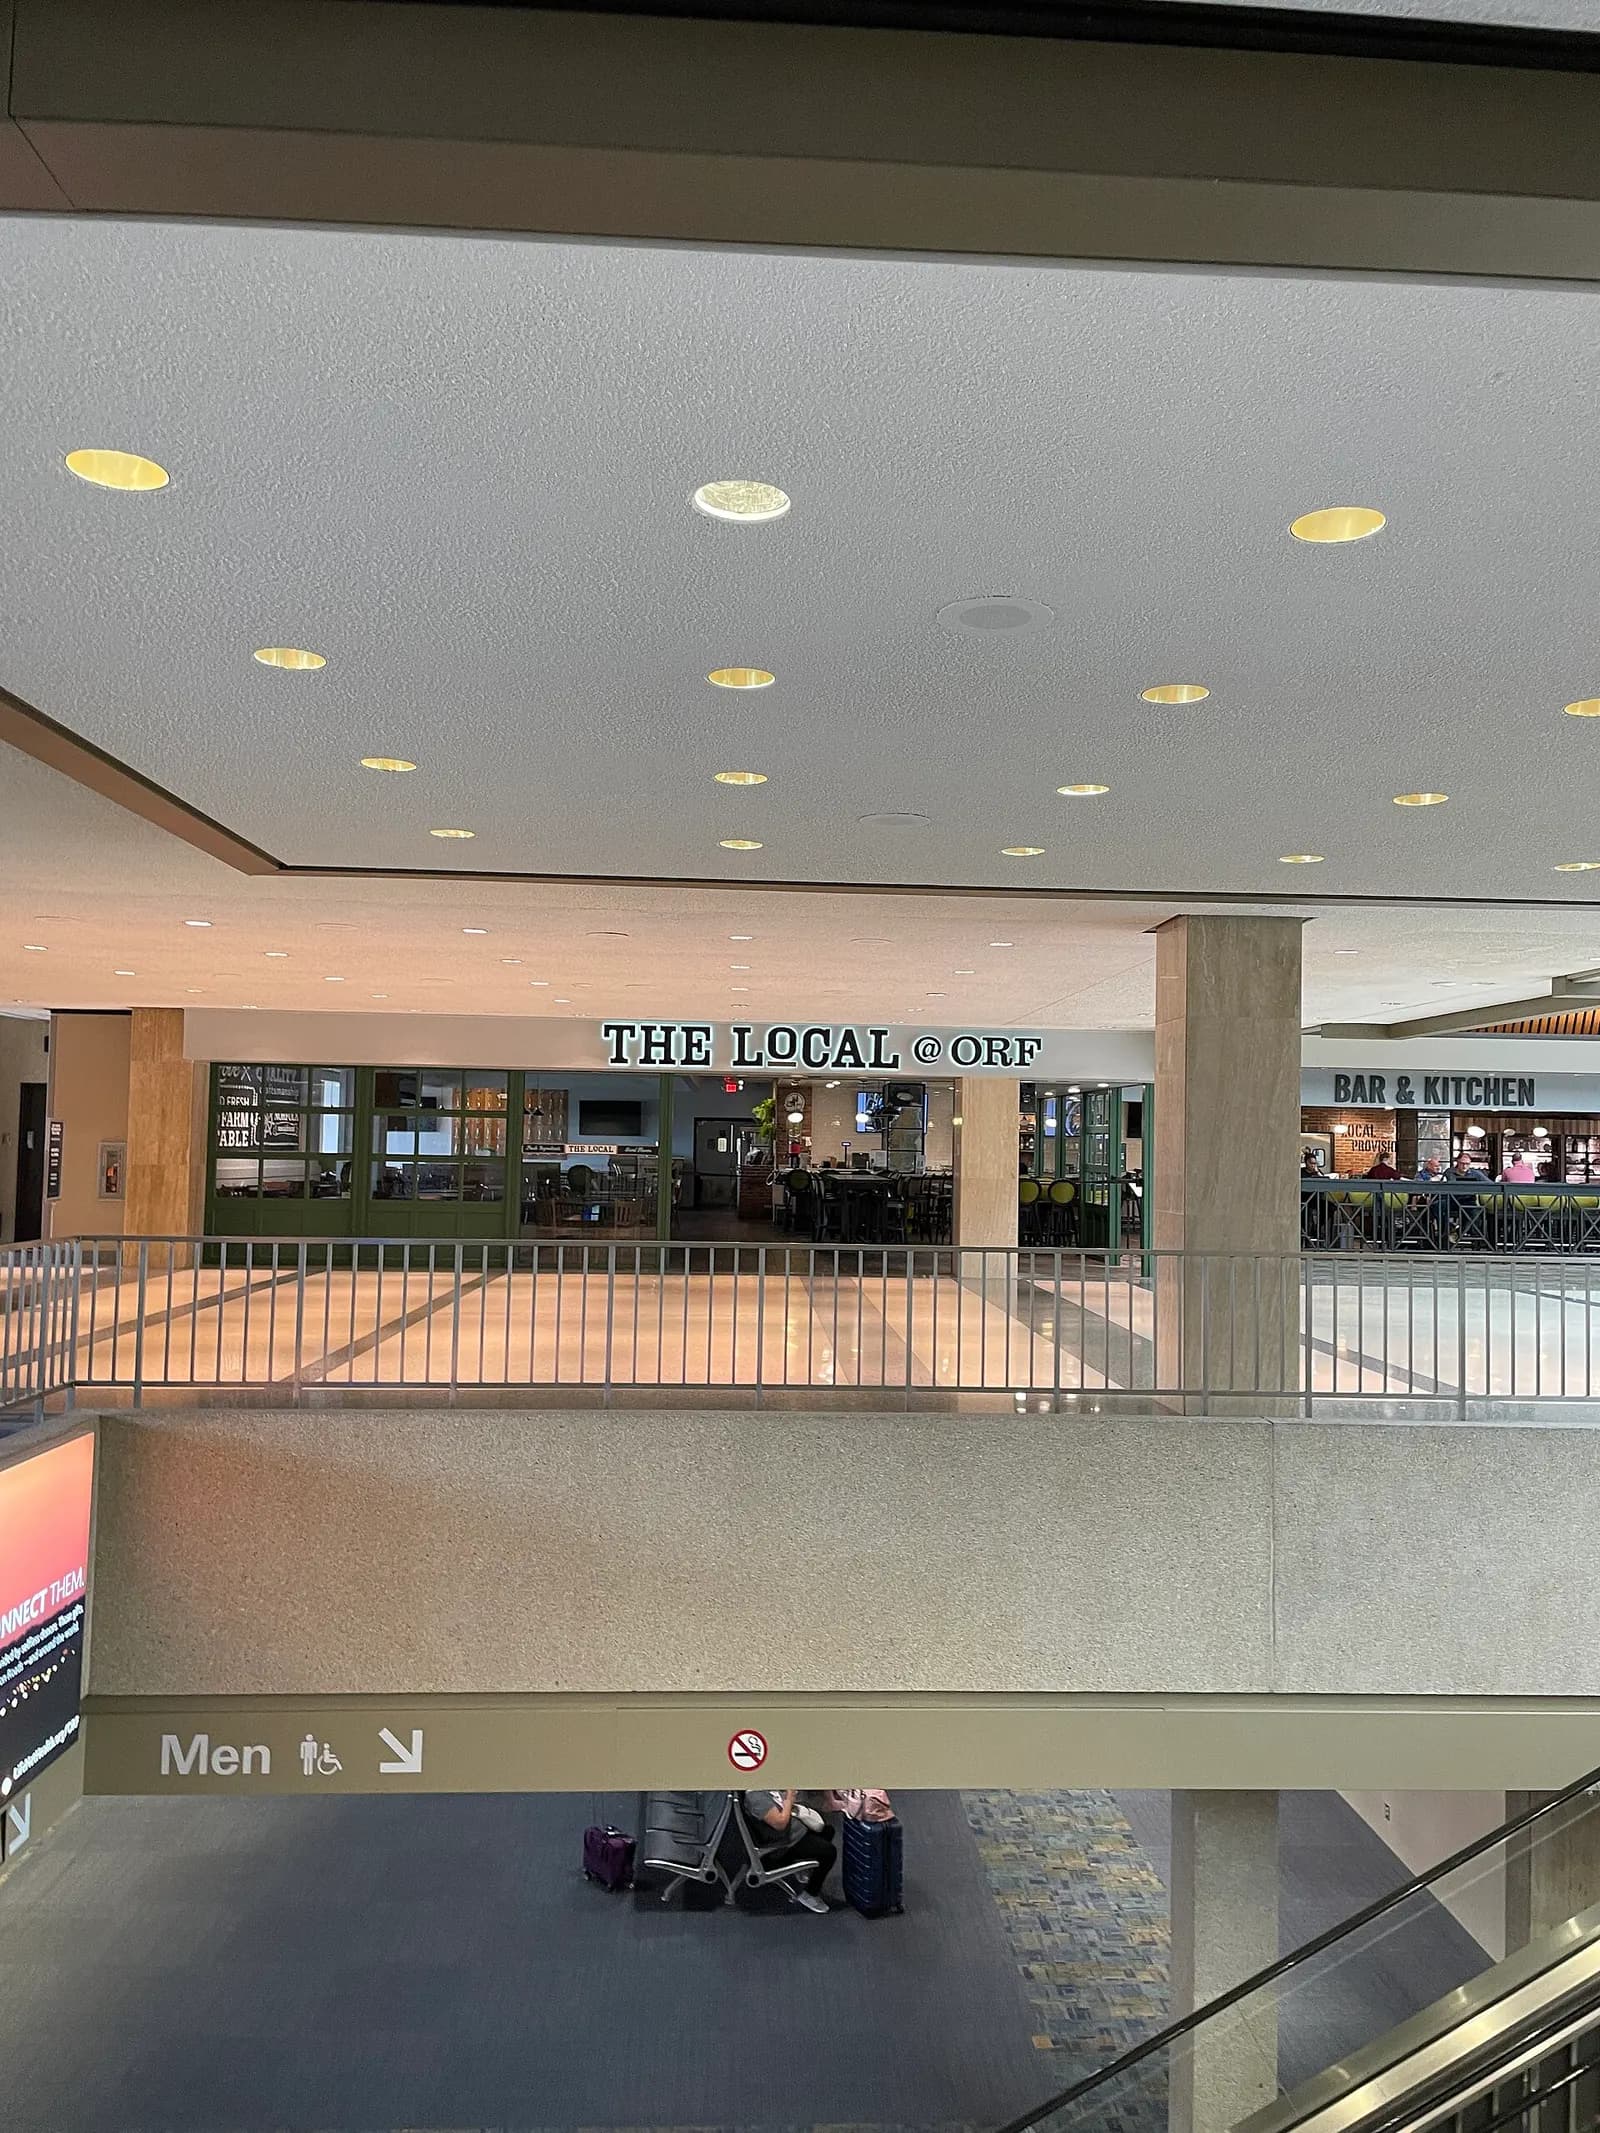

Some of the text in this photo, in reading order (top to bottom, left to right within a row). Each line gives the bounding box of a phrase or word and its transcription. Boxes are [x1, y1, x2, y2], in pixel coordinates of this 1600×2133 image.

[603, 1024, 1042, 1070] THE LOCAL @ ORF
[1334, 1074, 1535, 1106] BAR & KITCHEN
[221, 1112, 249, 1128] FARM
[217, 1130, 249, 1147] ABLE
[568, 1145, 614, 1153] THE LOCAL
[0, 1588, 48, 1639] NNECT
[49, 1565, 85, 1606] THEM.
[160, 1734, 271, 1775] Men
